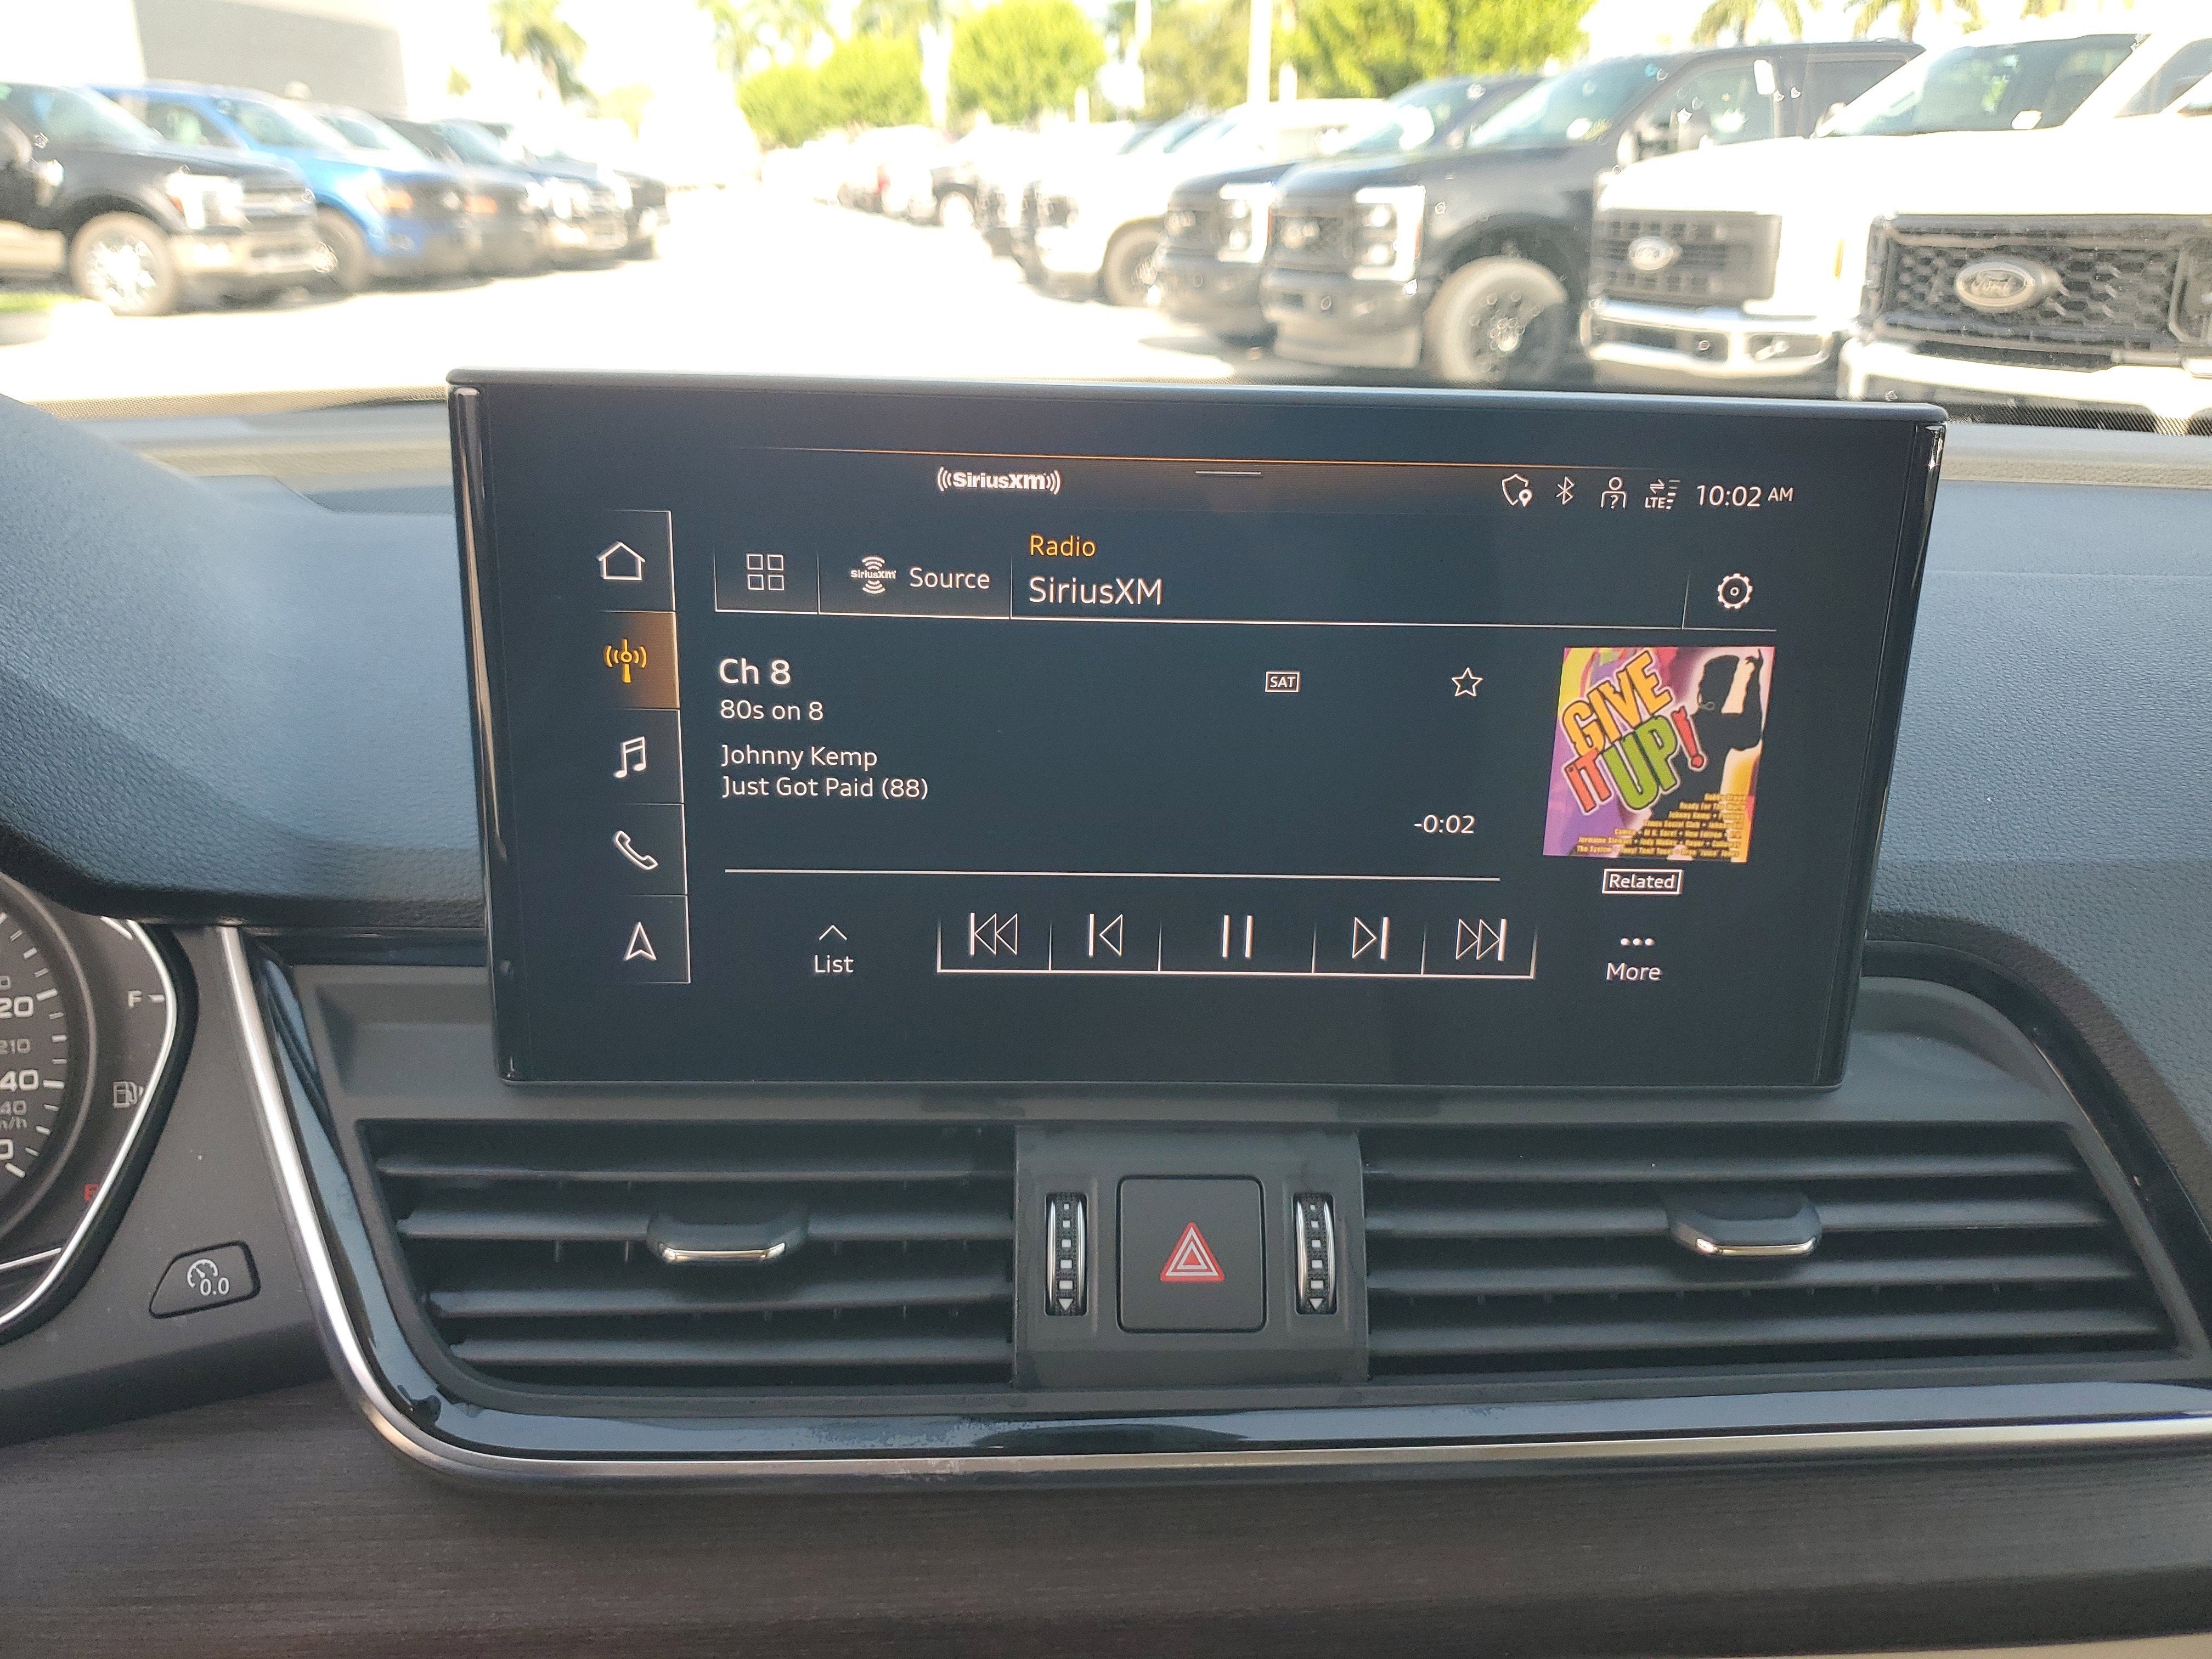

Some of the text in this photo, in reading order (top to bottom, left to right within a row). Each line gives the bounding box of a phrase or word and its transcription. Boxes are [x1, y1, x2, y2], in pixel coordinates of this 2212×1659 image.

[1645, 496, 1666, 509] LTE
[1696, 484, 1795, 507] 10:02 AM
[1030, 534, 1096, 557] Radio
[909, 566, 991, 590] Source
[1029, 576, 1163, 606] SiriusXM
[719, 658, 791, 685] Ch 8
[1269, 676, 1296, 689] SAT
[720, 699, 823, 721] 80s on 8
[1561, 650, 1673, 757] GIVE
[721, 743, 878, 771] Johnny Kemp
[1563, 706, 1705, 813] IT UP!
[722, 775, 929, 800] Just Got Paid (88)
[1414, 814, 1476, 834] -0:02
[1609, 874, 1676, 890] Related
[814, 955, 854, 973] List
[1606, 962, 1662, 981] More
[128, 990, 142, 1008] F
[200, 1277, 230, 1296] 0.0
